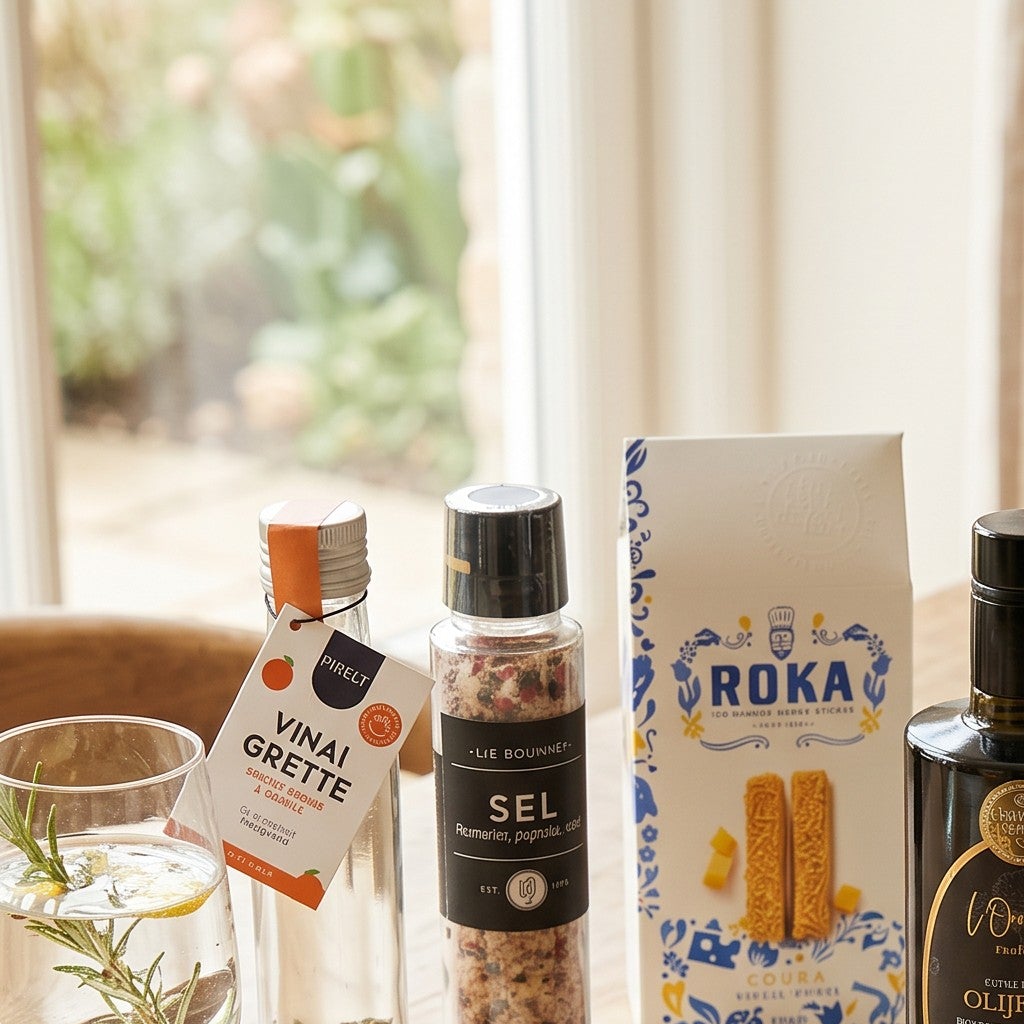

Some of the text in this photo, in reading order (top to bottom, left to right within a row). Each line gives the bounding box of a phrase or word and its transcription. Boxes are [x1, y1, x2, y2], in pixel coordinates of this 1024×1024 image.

[711, 661, 854, 706] ROKA
[275, 710, 350, 770] VINAI
[242, 733, 353, 804] GRETTE
[489, 792, 557, 822] SEL
[747, 971, 824, 987] COURA
